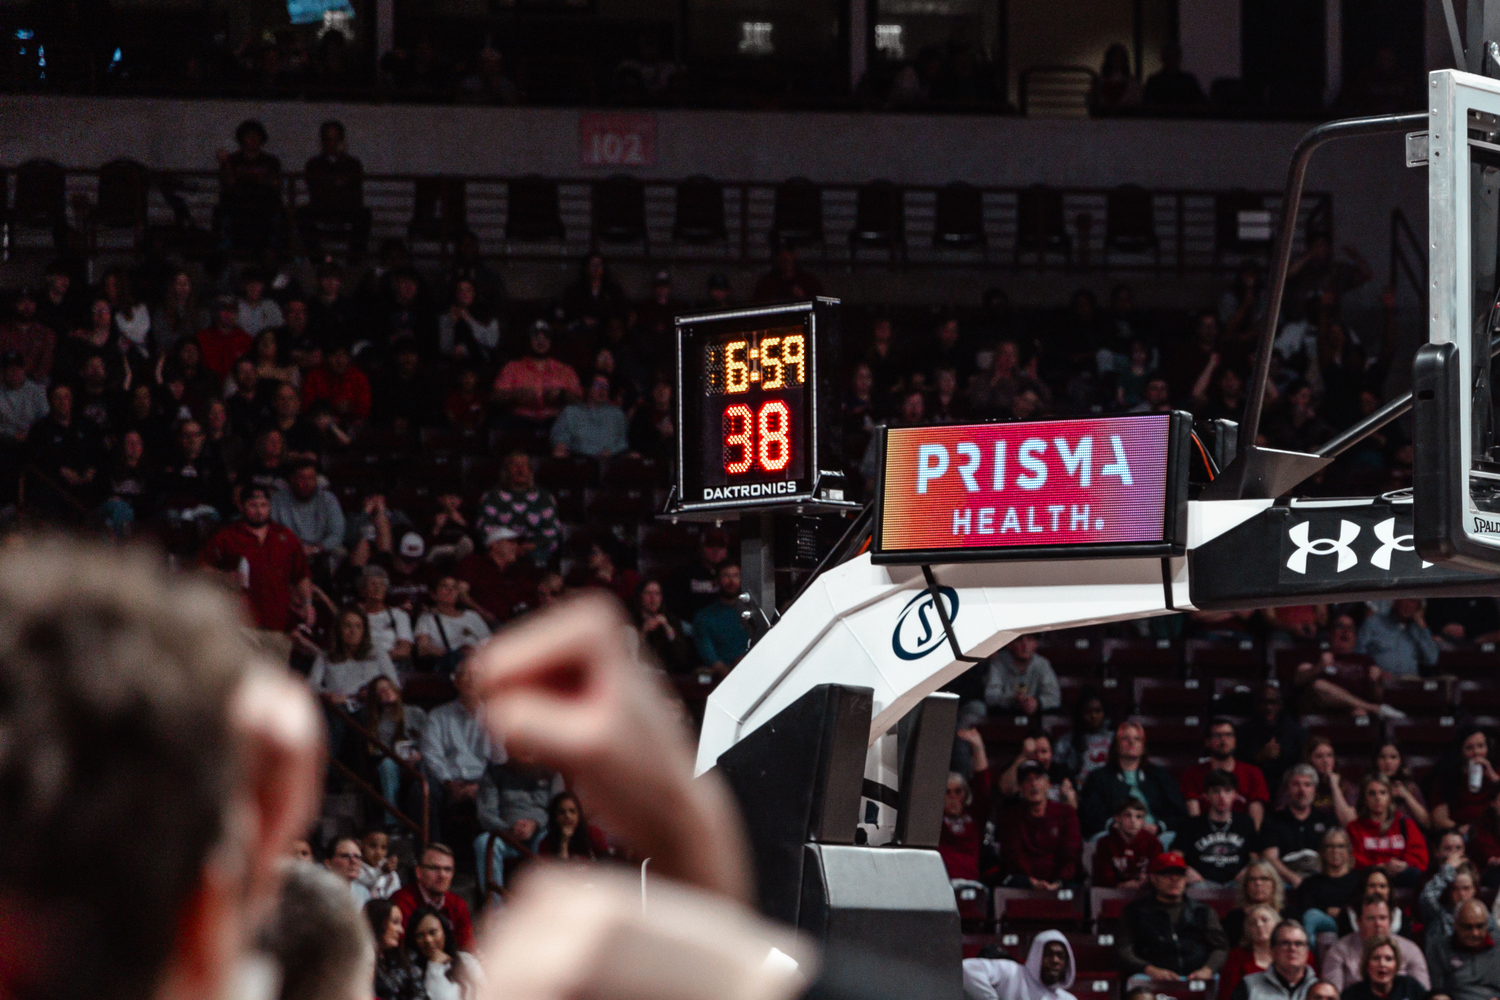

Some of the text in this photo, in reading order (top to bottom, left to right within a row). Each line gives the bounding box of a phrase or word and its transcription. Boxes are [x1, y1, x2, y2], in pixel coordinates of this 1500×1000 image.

[725, 334, 805, 394] 6:59
[724, 400, 791, 474] 38
[915, 434, 1135, 494] PRISMA
[703, 480, 797, 501] DAKTRONICS
